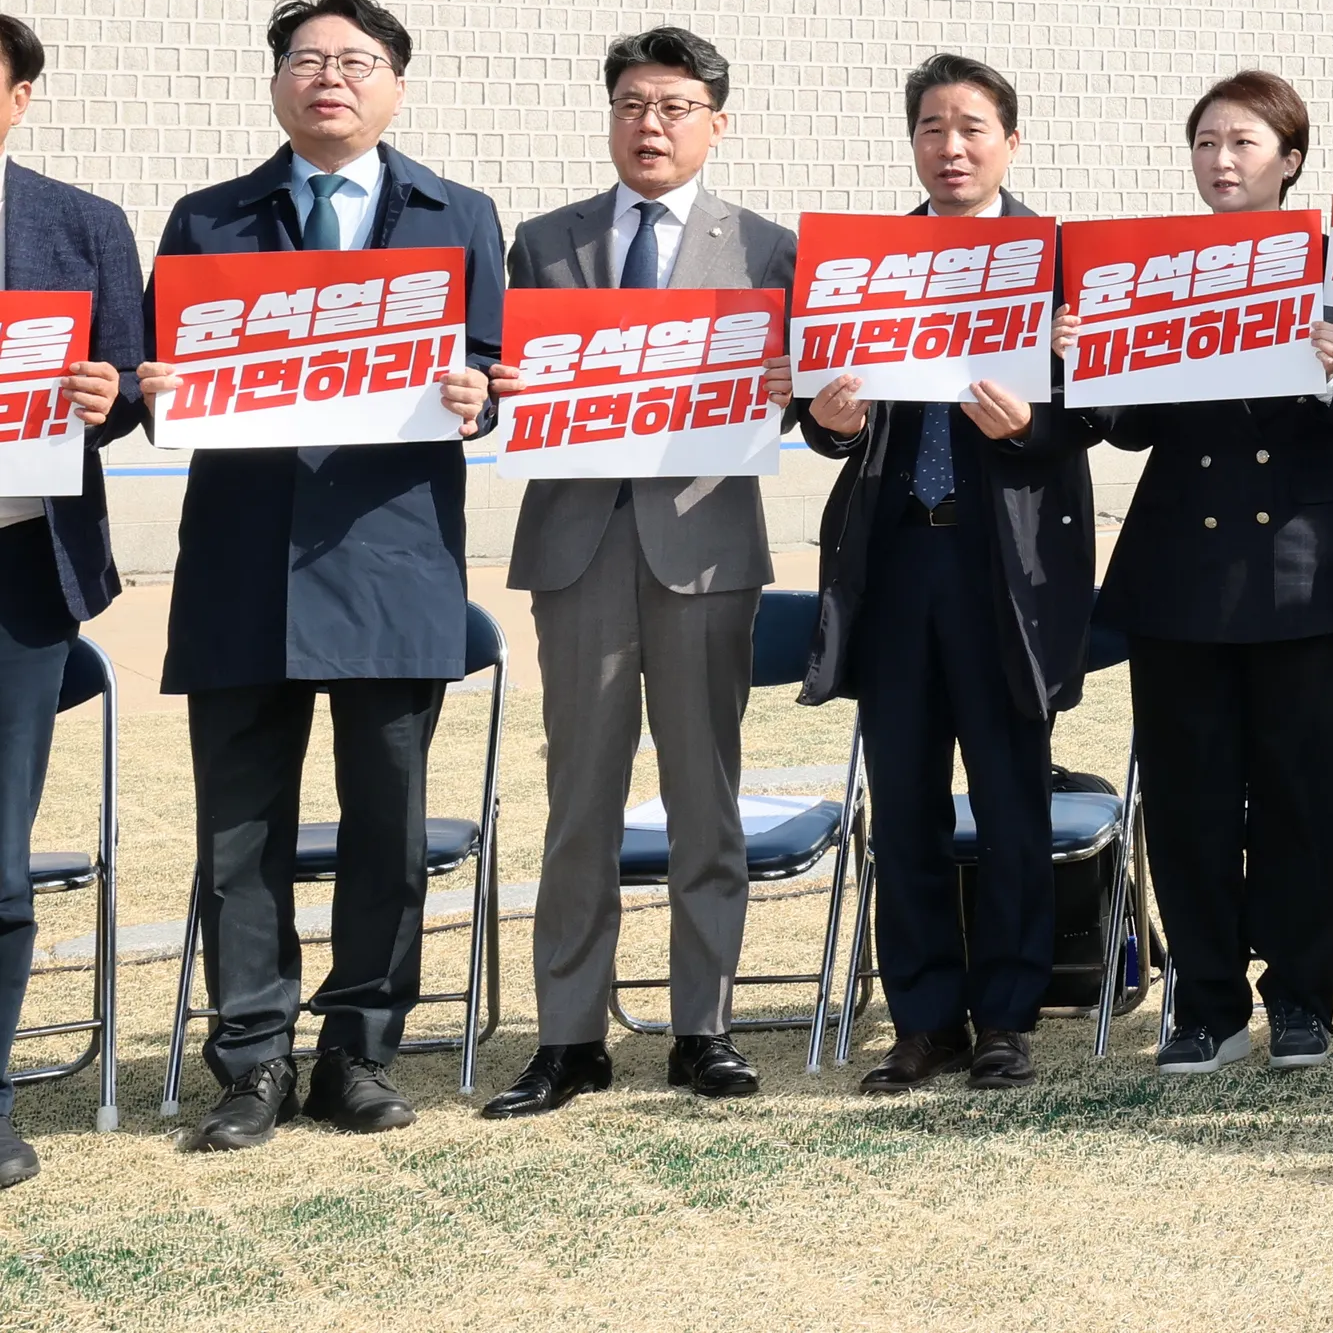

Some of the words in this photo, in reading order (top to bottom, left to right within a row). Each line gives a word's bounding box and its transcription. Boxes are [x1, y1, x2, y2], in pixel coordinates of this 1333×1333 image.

[174, 270, 451, 356] 윤석열을
[806, 239, 1044, 309] 윤석열을
[1078, 231, 1310, 317] 윤석열을
[165, 333, 457, 421] 파면하라!
[518, 311, 771, 387] 윤석열을
[797, 301, 1045, 373] 파면하라!
[1072, 293, 1316, 382] 파면하라!
[505, 375, 770, 453] 파면하라!
